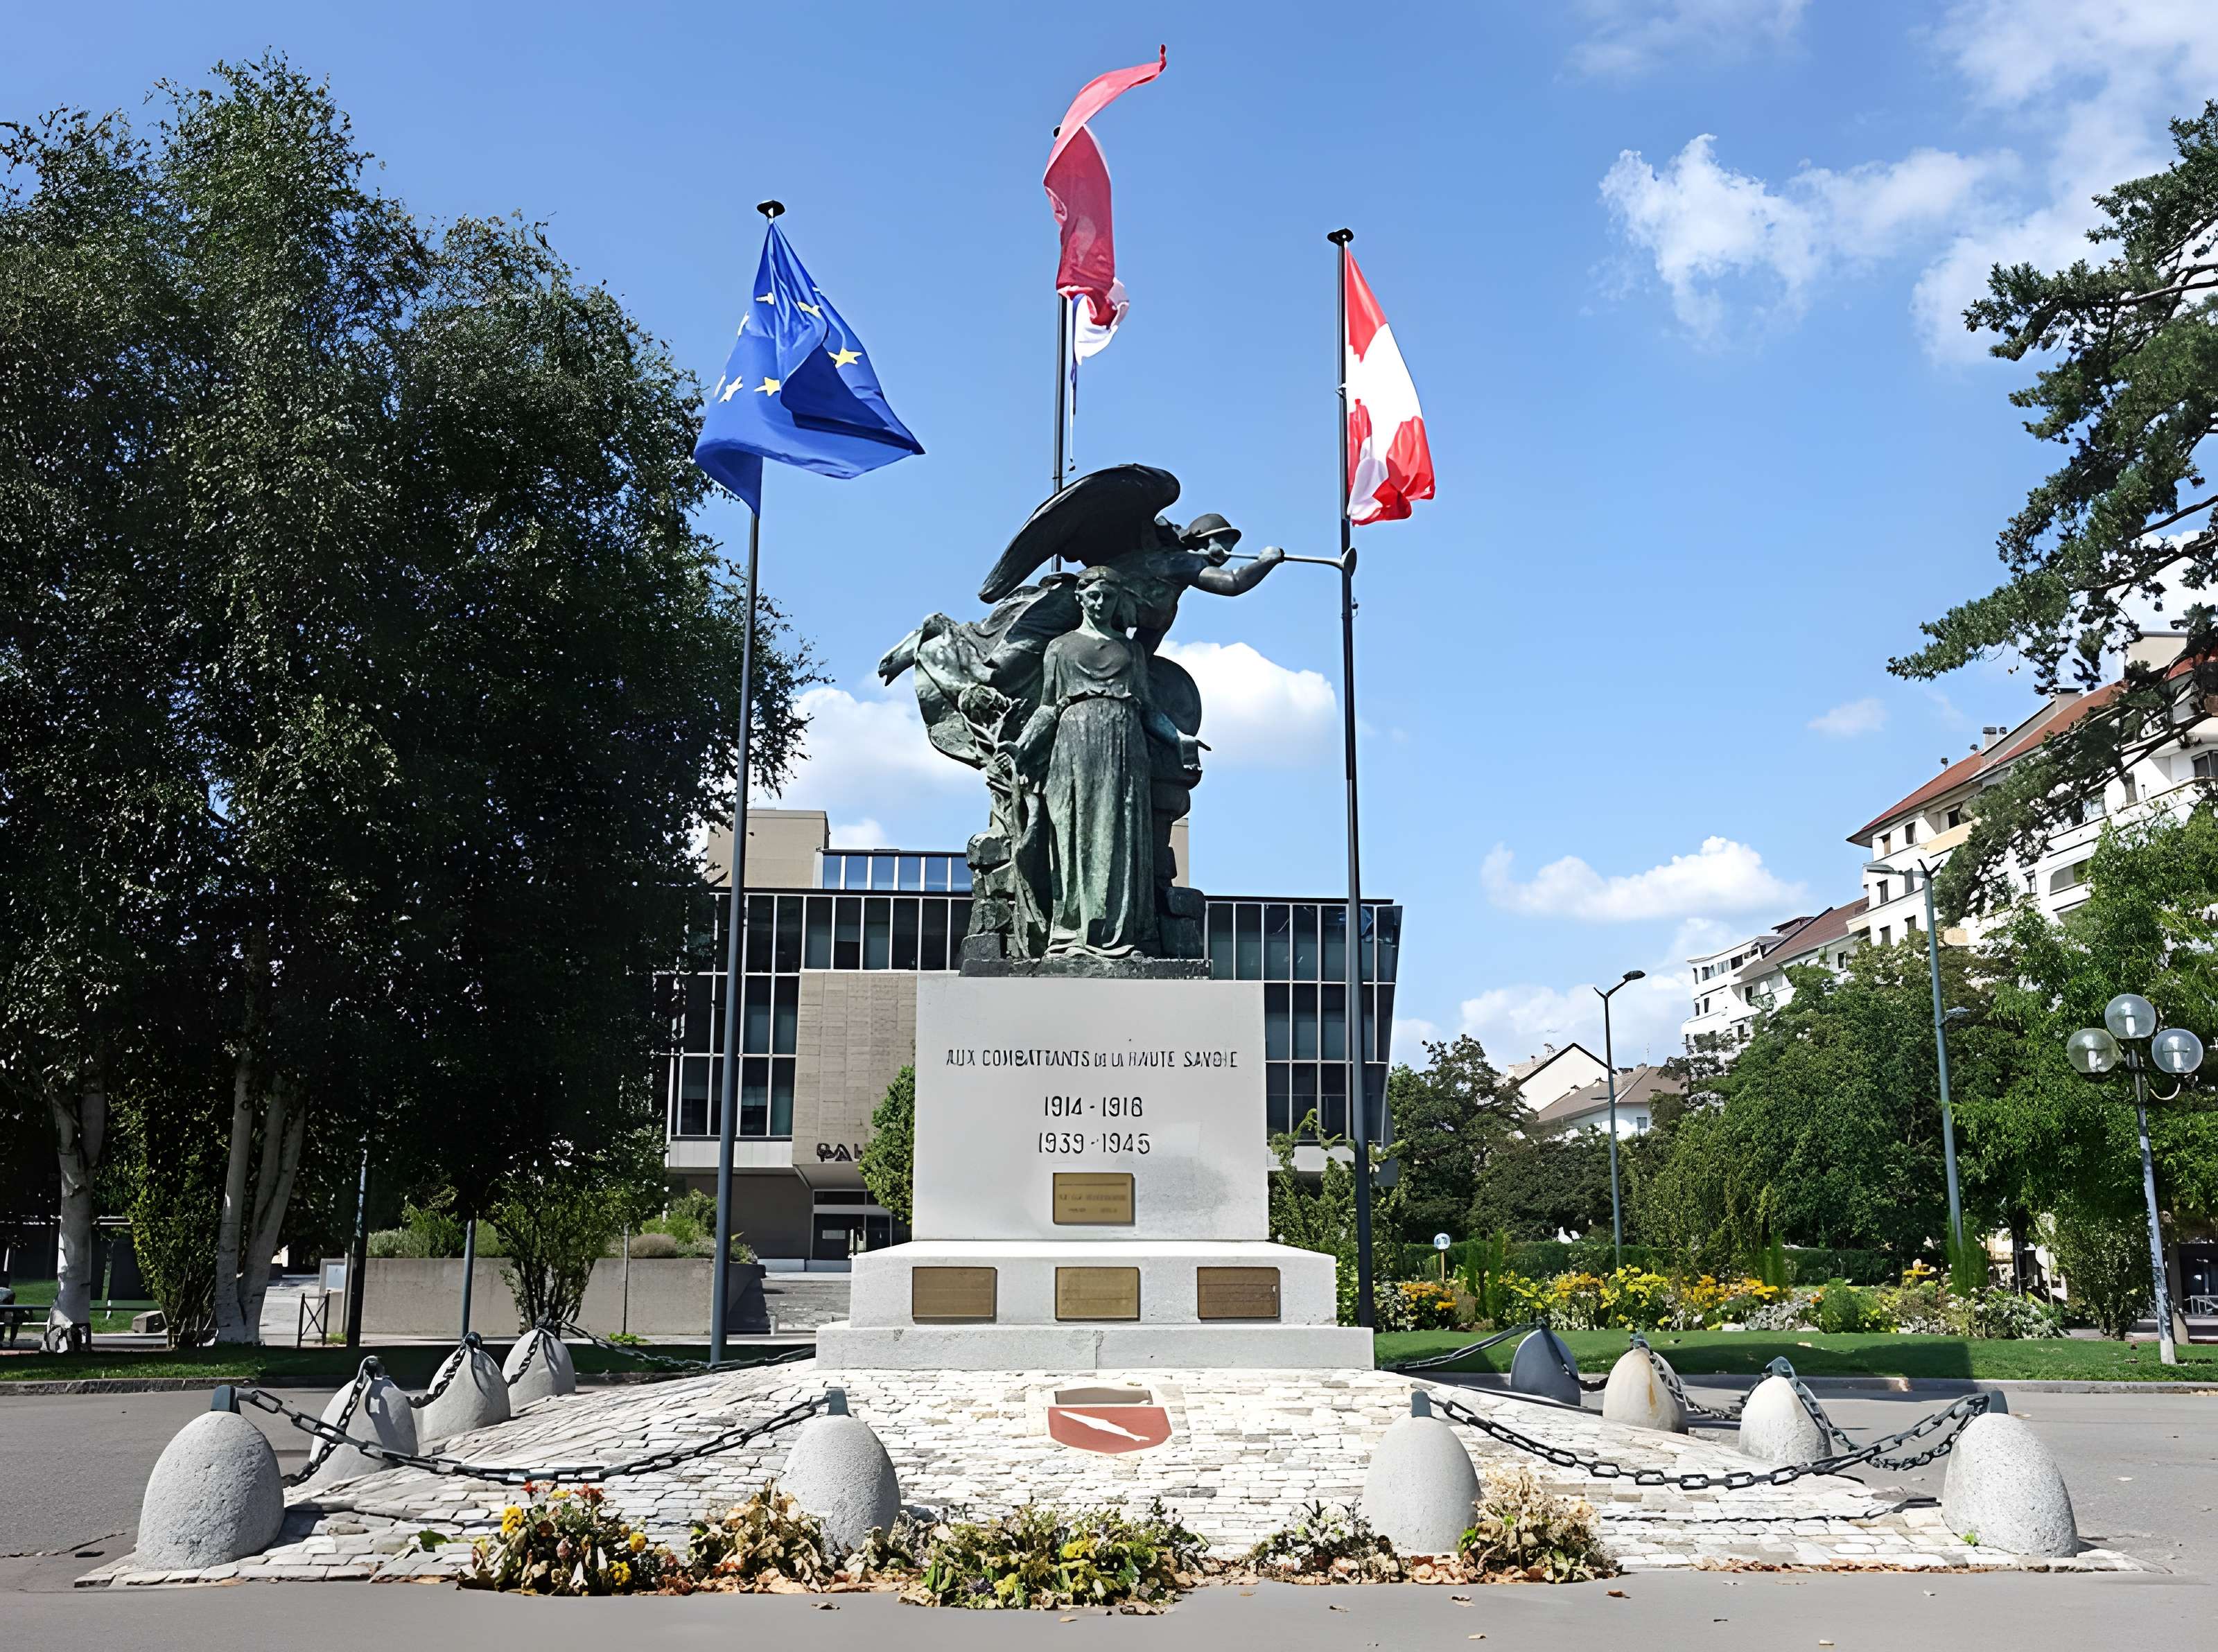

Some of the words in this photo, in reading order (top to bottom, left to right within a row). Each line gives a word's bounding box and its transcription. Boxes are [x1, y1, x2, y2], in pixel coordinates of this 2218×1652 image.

[946, 1049, 976, 1066] AUX
[982, 1049, 1090, 1067] COMBATTANTS
[1128, 1051, 1176, 1068] HAUTE
[1183, 1051, 1239, 1068] SAVOIE
[1045, 1096, 1083, 1117] 1914
[1102, 1096, 1143, 1118] 1918
[1038, 1132, 1084, 1154] 1939
[1102, 1132, 1151, 1155] 1945
